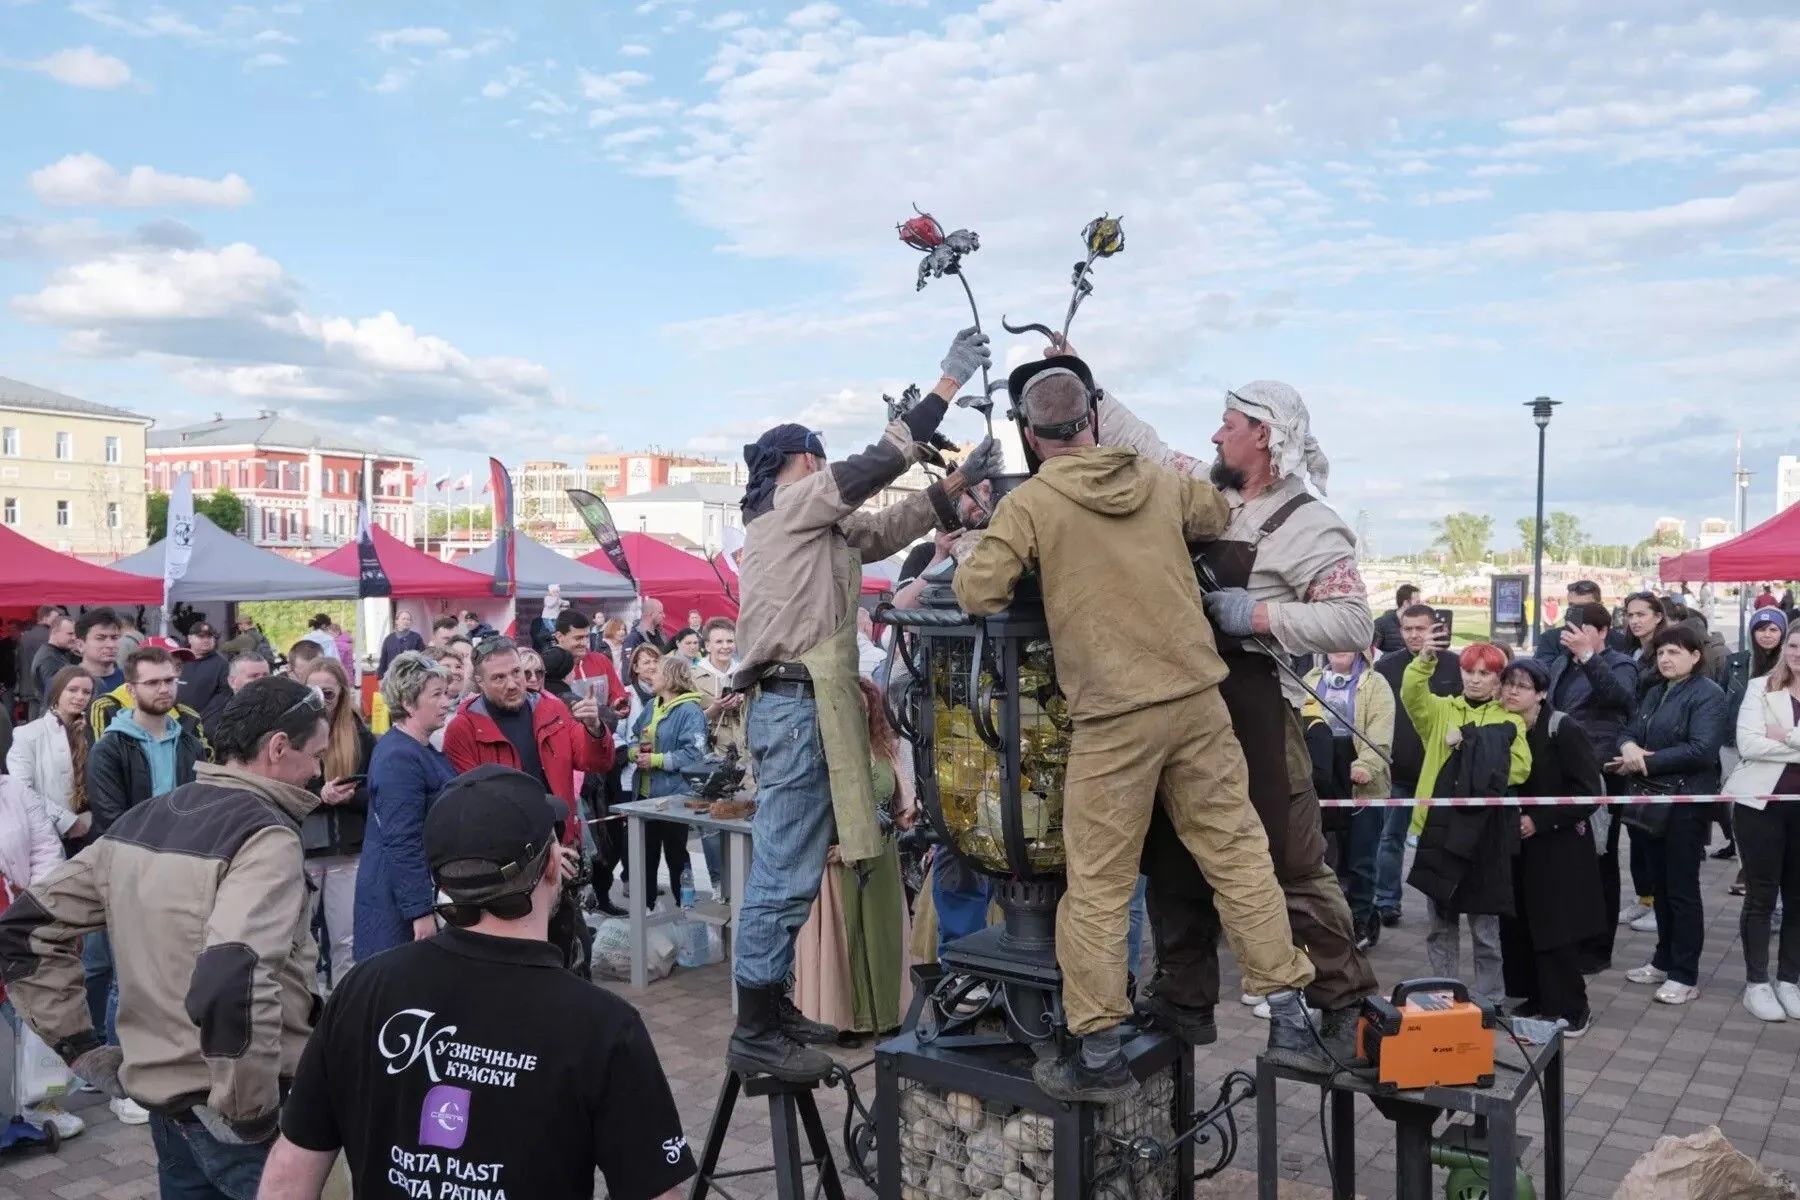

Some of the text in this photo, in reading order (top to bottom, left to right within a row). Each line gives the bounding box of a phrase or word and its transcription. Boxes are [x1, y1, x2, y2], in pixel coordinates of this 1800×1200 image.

[445, 1061, 517, 1088] КРАСКИ
[446, 1156, 504, 1183] PLAST
[440, 1181, 508, 1200] PATINA
